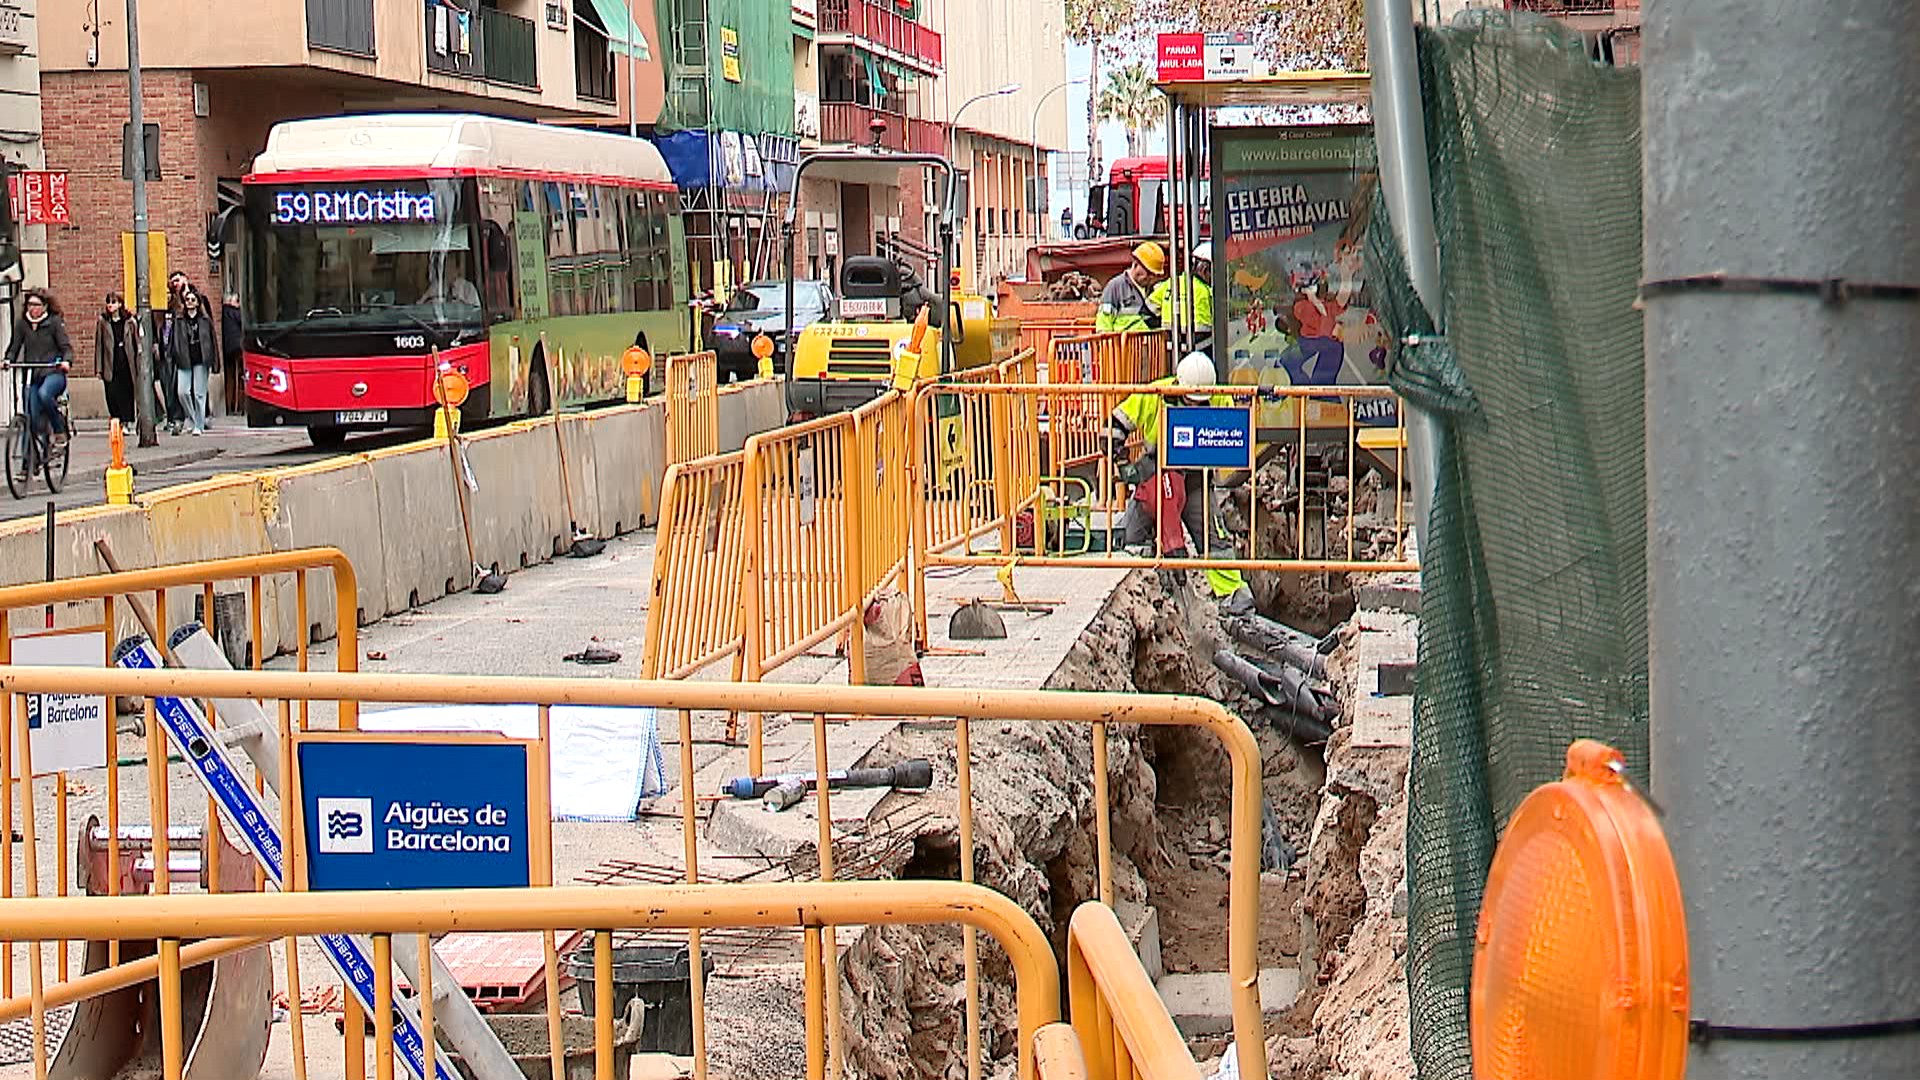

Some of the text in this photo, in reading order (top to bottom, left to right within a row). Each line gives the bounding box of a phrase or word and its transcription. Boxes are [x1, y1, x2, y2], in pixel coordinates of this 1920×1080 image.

[1165, 45, 1197, 55] PARADA
[276, 189, 434, 223] 59 R.M.Cristina
[1228, 184, 1308, 211] CELEBRA
[1230, 201, 1350, 233] EL CARNAVAL
[394, 336, 425, 348] 1603
[1197, 427, 1243, 438] Aigües de
[1198, 437, 1244, 447] Barcelona
[47, 704, 99, 723] Barcelona
[384, 802, 507, 829] Aigües de
[254, 824, 283, 868] TUBES
[387, 829, 510, 852] Barcelona
[329, 934, 358, 969] TUBES
